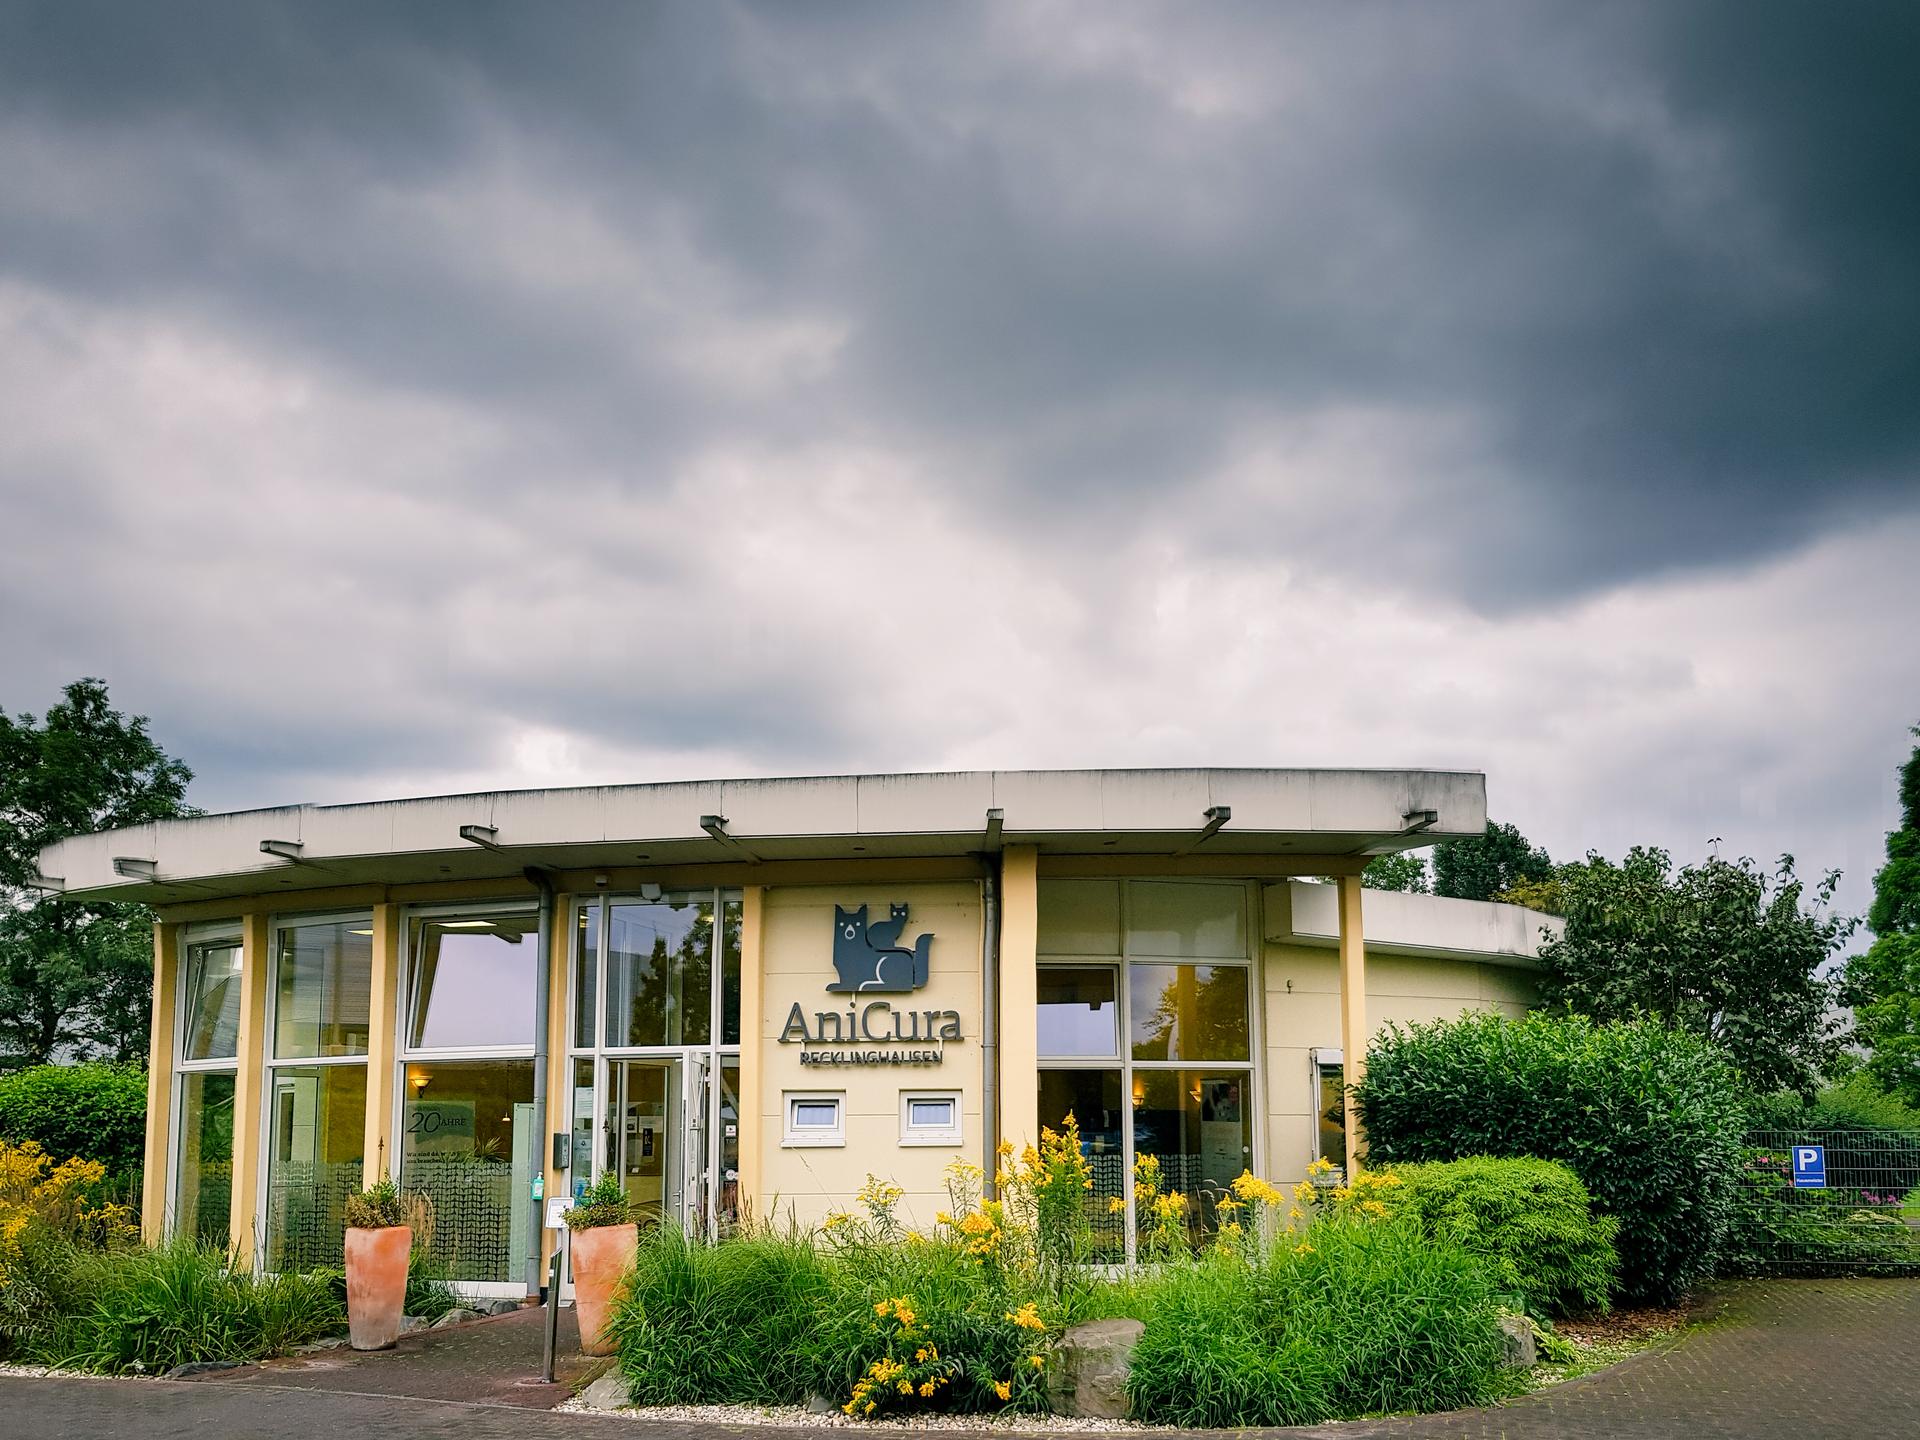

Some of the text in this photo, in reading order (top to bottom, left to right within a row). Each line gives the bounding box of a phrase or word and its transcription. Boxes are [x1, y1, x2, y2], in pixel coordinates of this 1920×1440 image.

[777, 1001, 965, 1044] AniCura
[800, 1050, 943, 1066] RECKLINGHAUSEN
[1798, 1149, 1818, 1171] P
